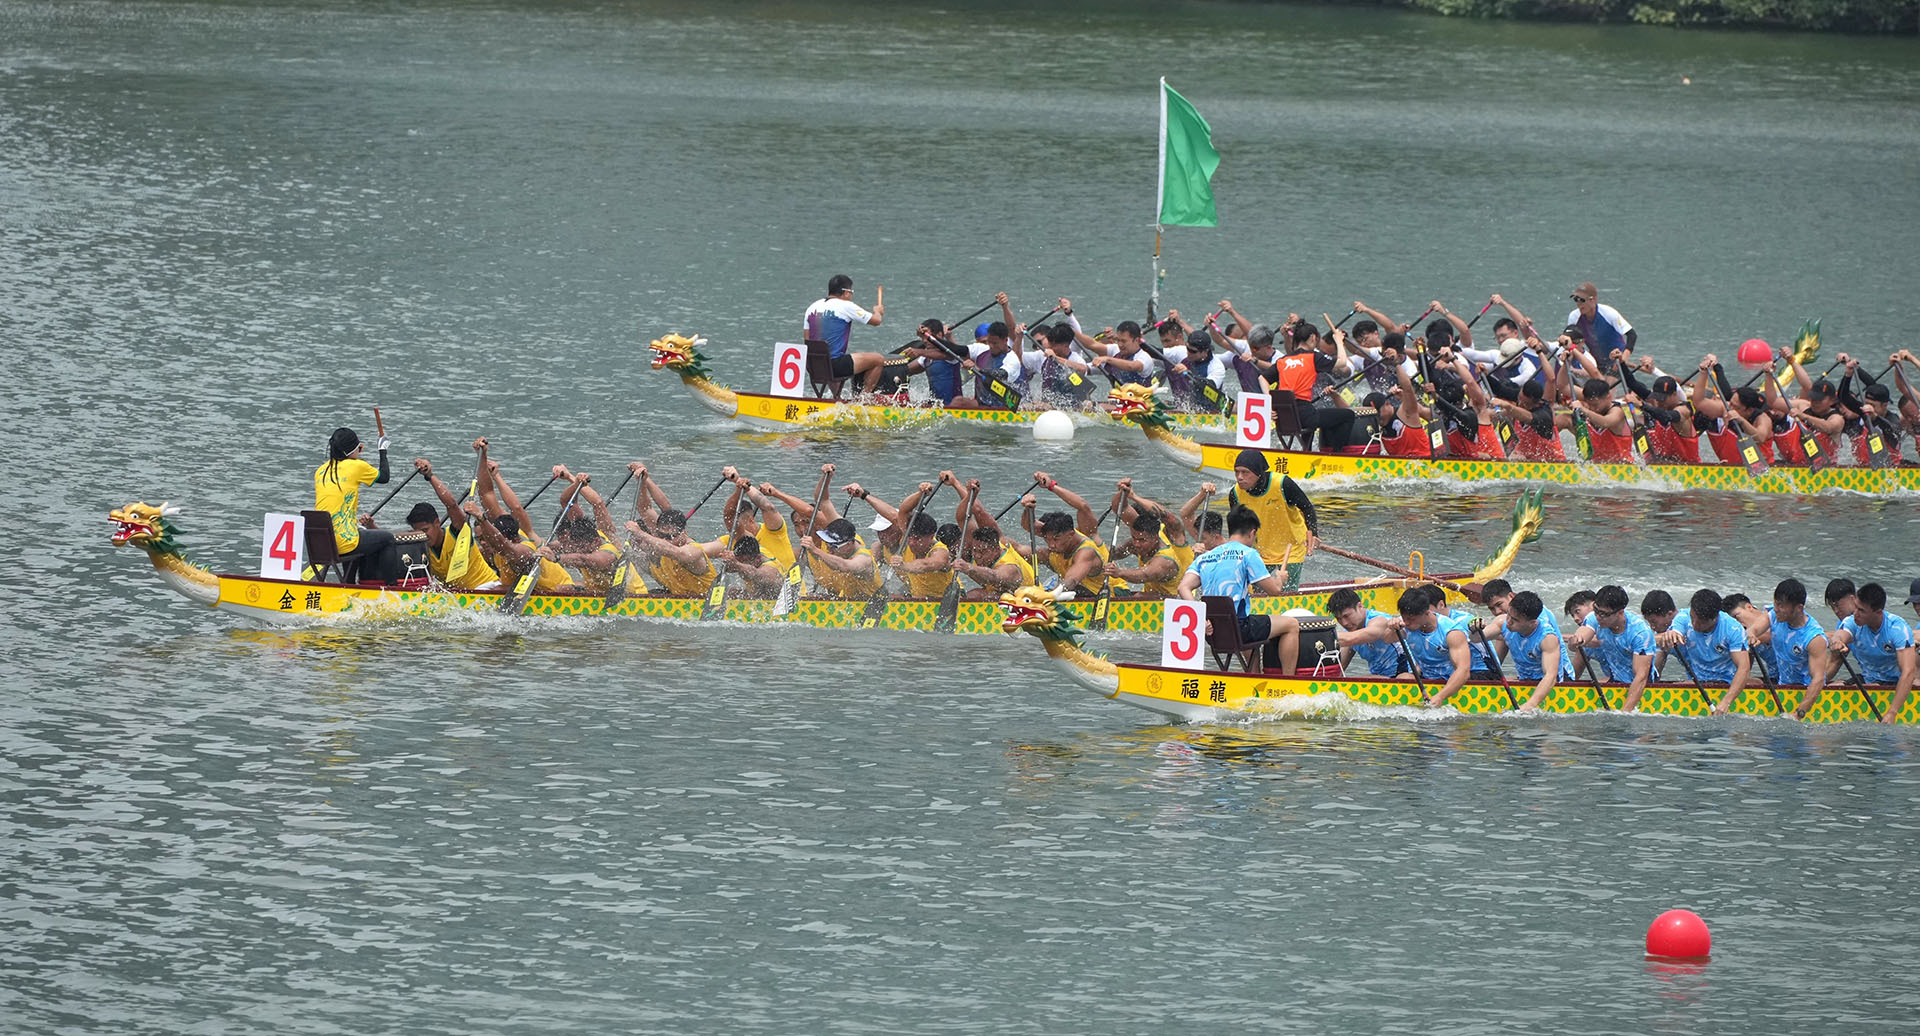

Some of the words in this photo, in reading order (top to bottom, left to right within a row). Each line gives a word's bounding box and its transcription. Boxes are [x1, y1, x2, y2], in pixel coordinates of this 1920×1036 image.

[779, 347, 801, 389] 6
[1243, 398, 1265, 441] 5
[269, 520, 297, 571] 4
[278, 588, 323, 612] 金龍
[1170, 605, 1198, 661] 3
[1181, 678, 1228, 703] 福龍
